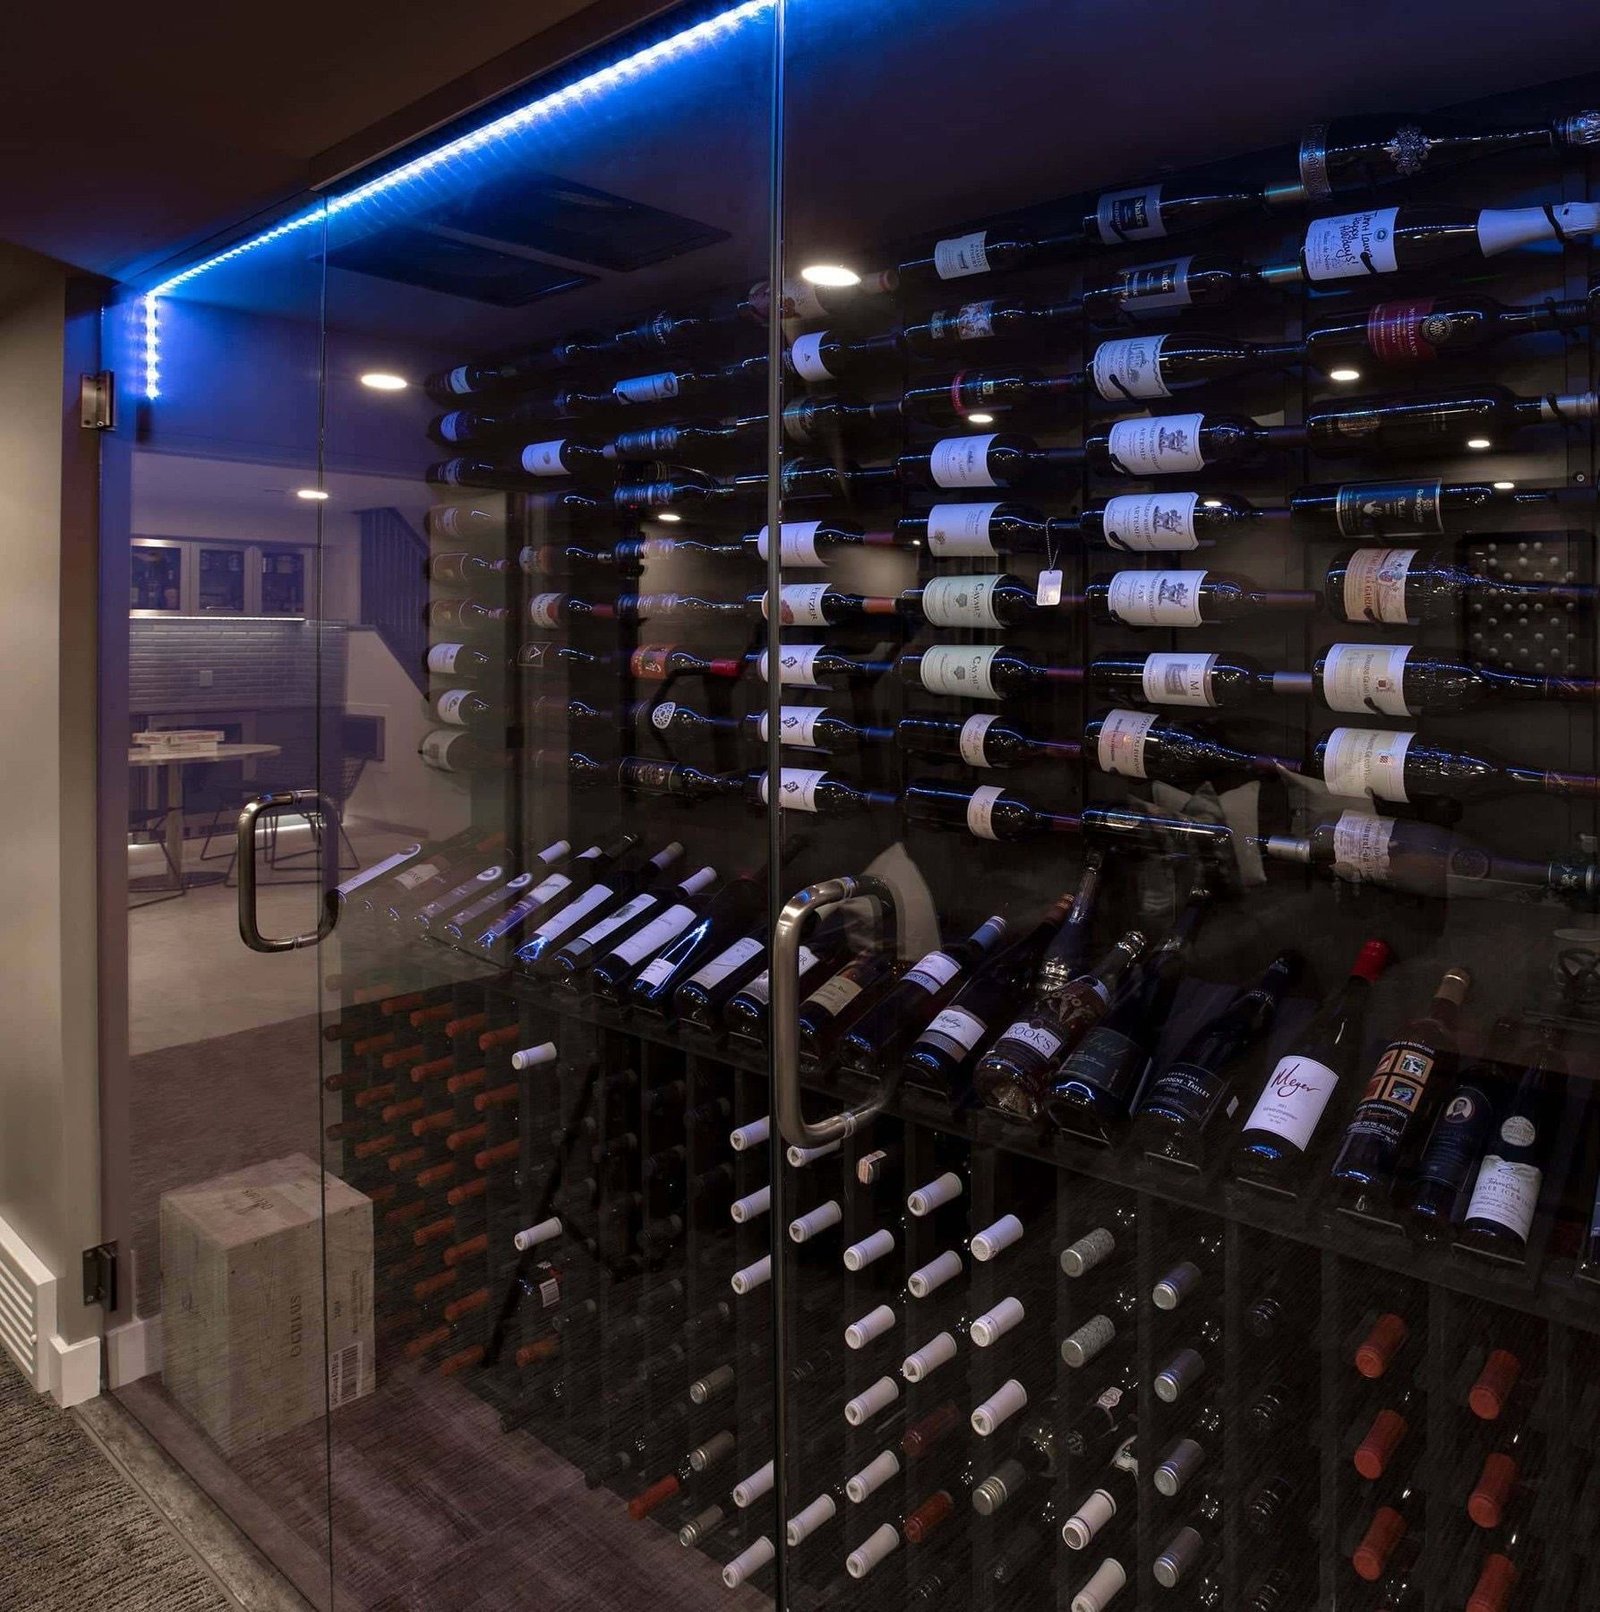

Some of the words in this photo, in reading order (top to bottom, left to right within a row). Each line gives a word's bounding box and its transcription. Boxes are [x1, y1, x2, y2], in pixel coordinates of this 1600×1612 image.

[1134, 199, 1145, 227] Shafer
[1190, 663, 1202, 698] SIMI
[1270, 1063, 1321, 1098] Meyer
